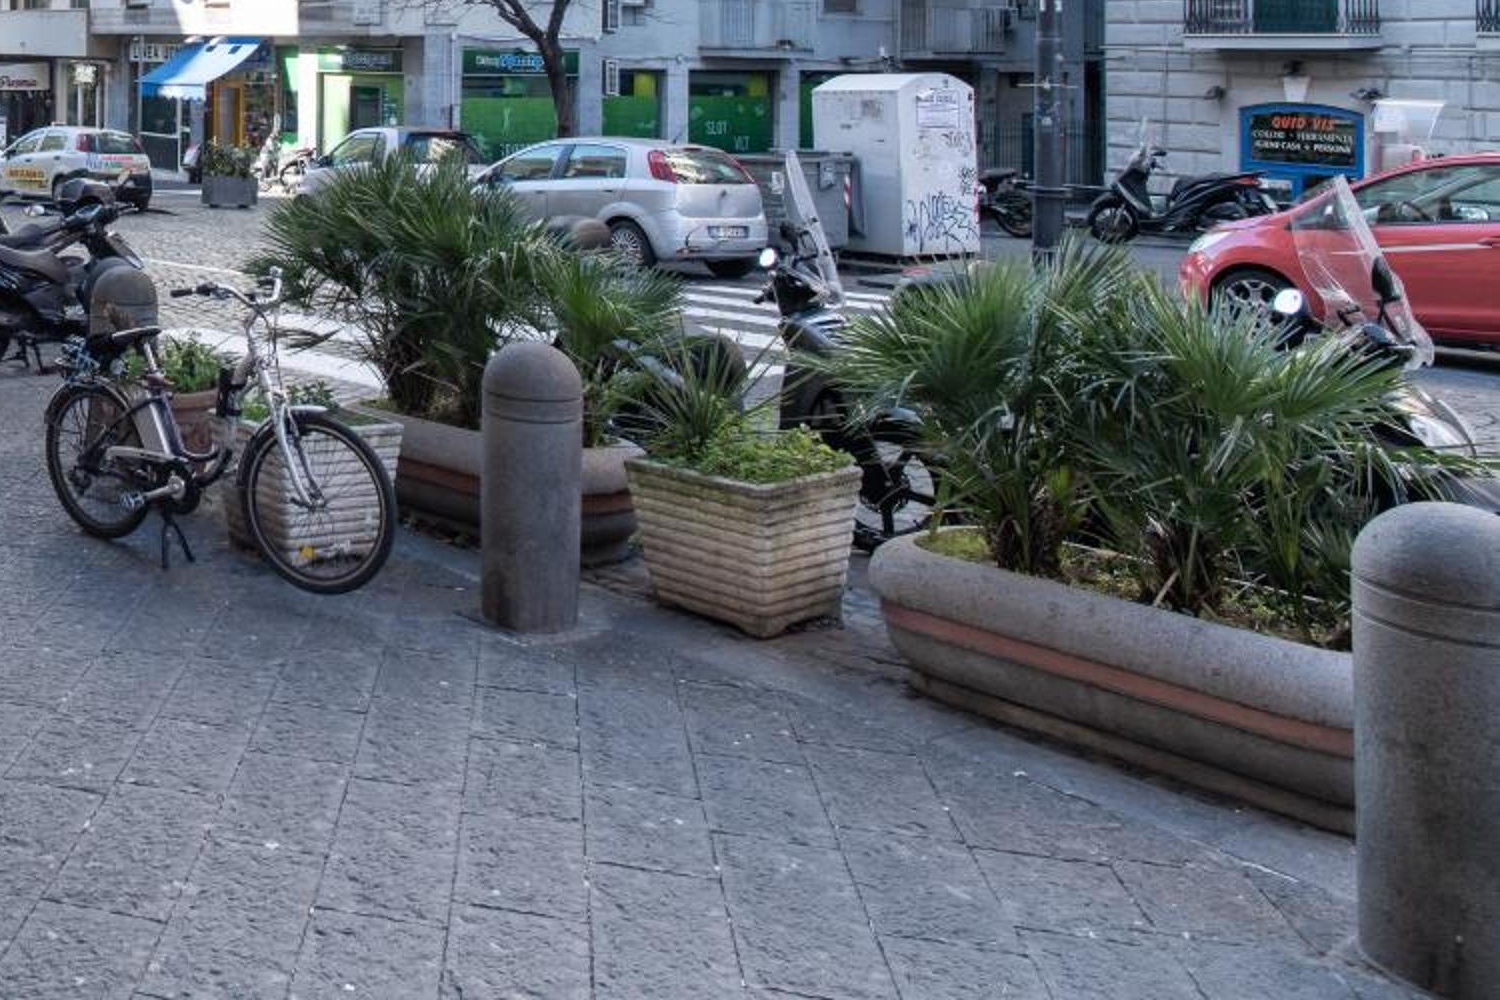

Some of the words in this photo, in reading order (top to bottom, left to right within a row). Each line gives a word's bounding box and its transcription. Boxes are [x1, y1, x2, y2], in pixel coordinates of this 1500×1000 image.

[705, 119, 728, 136] SLOT
[1272, 115, 1306, 130] QUID
[734, 135, 750, 152] VLT
